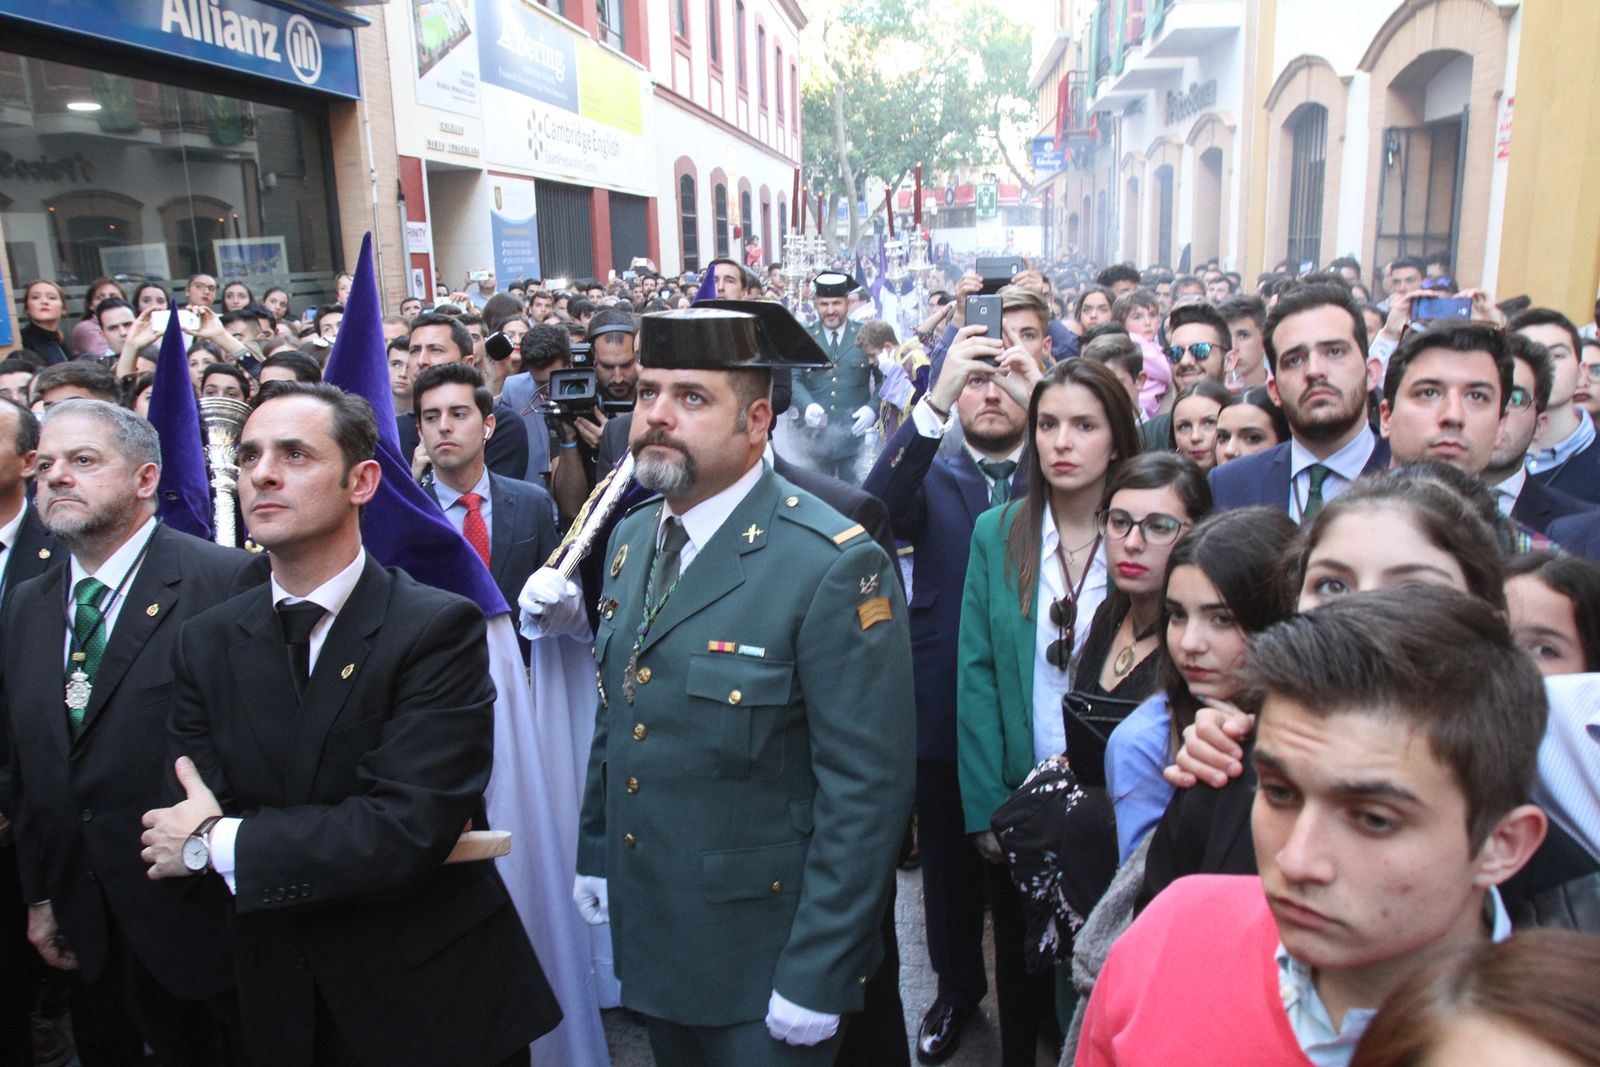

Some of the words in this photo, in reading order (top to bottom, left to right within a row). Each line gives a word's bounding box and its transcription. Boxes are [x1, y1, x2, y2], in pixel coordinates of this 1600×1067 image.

[161, 0, 282, 63] Allianz
[544, 113, 591, 154] Cambridge
[592, 129, 620, 160] English
[407, 227, 427, 238] RINITY
